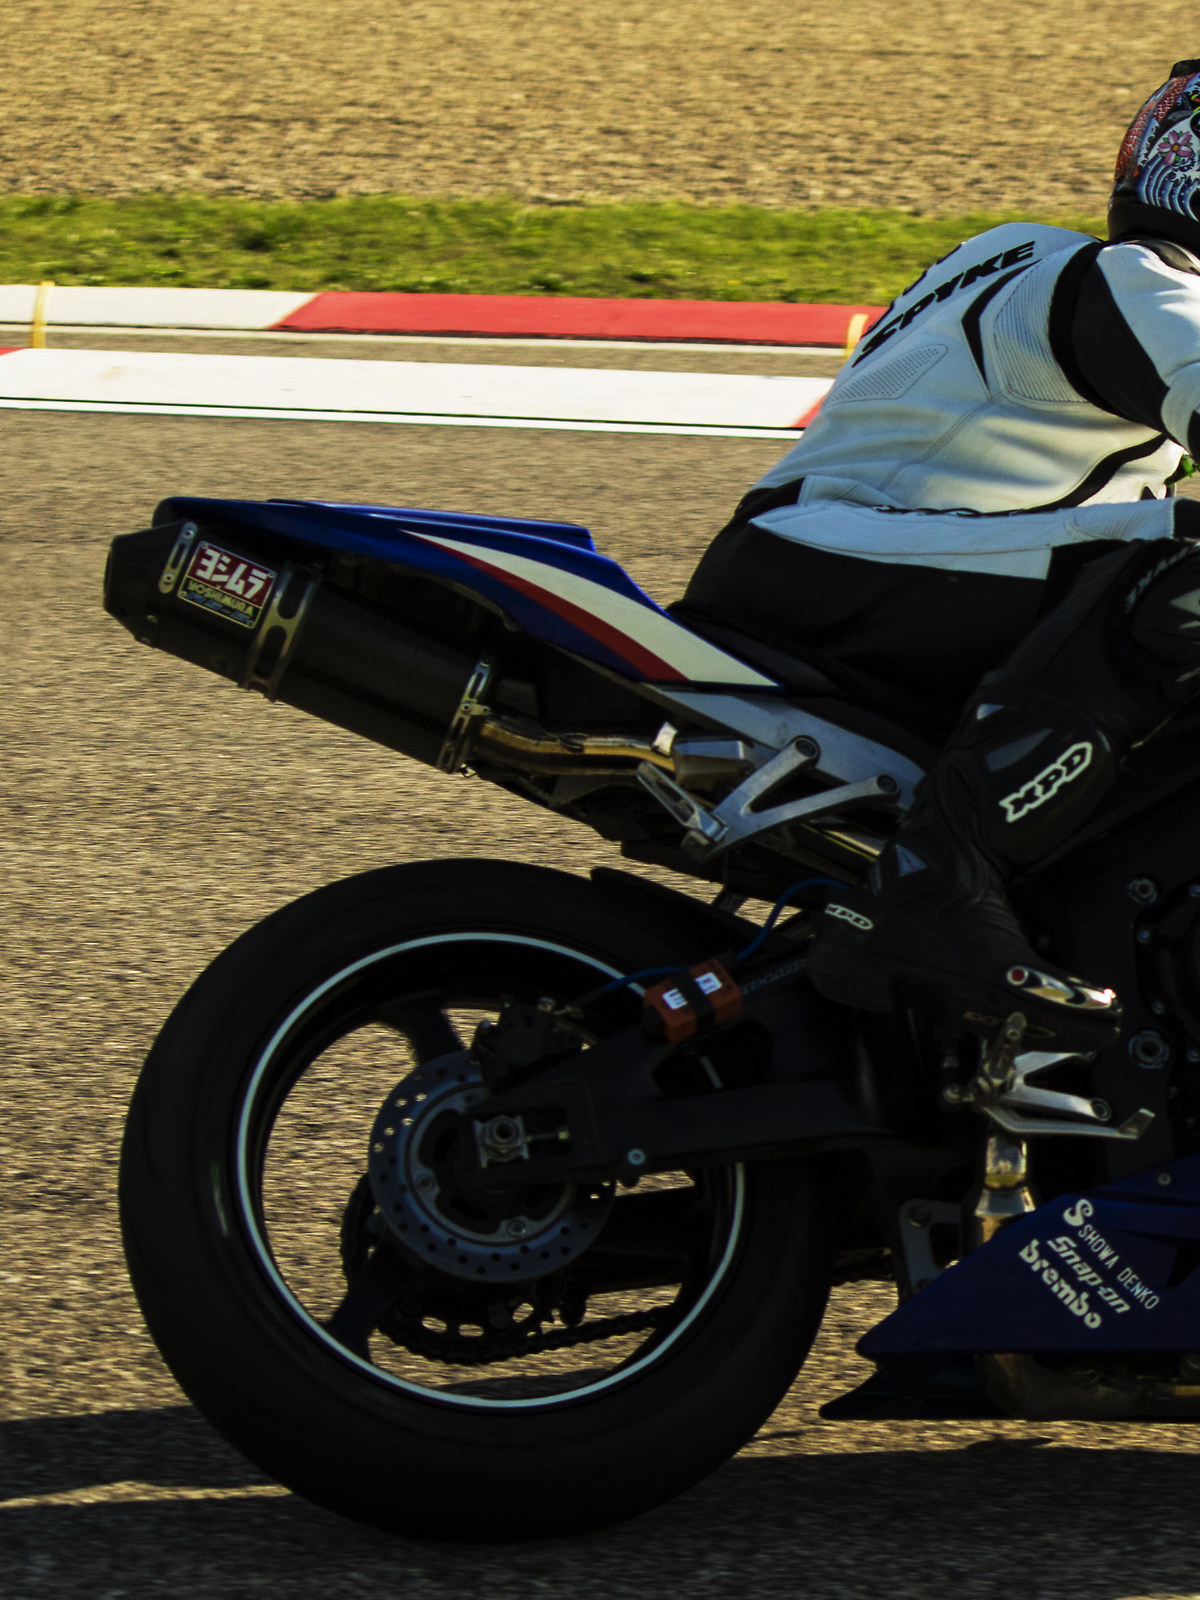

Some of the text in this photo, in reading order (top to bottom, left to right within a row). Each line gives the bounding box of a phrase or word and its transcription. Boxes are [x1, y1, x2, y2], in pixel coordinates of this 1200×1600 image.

[851, 241, 1035, 368] SPYKE
[196, 548, 268, 600] ヨシムラ
[998, 741, 1093, 823] XPD
[1019, 1239, 1102, 1329] brembo
[1047, 1236, 1131, 1313] Snap-on
[1078, 1224, 1160, 1310] SHOWA DENKO
